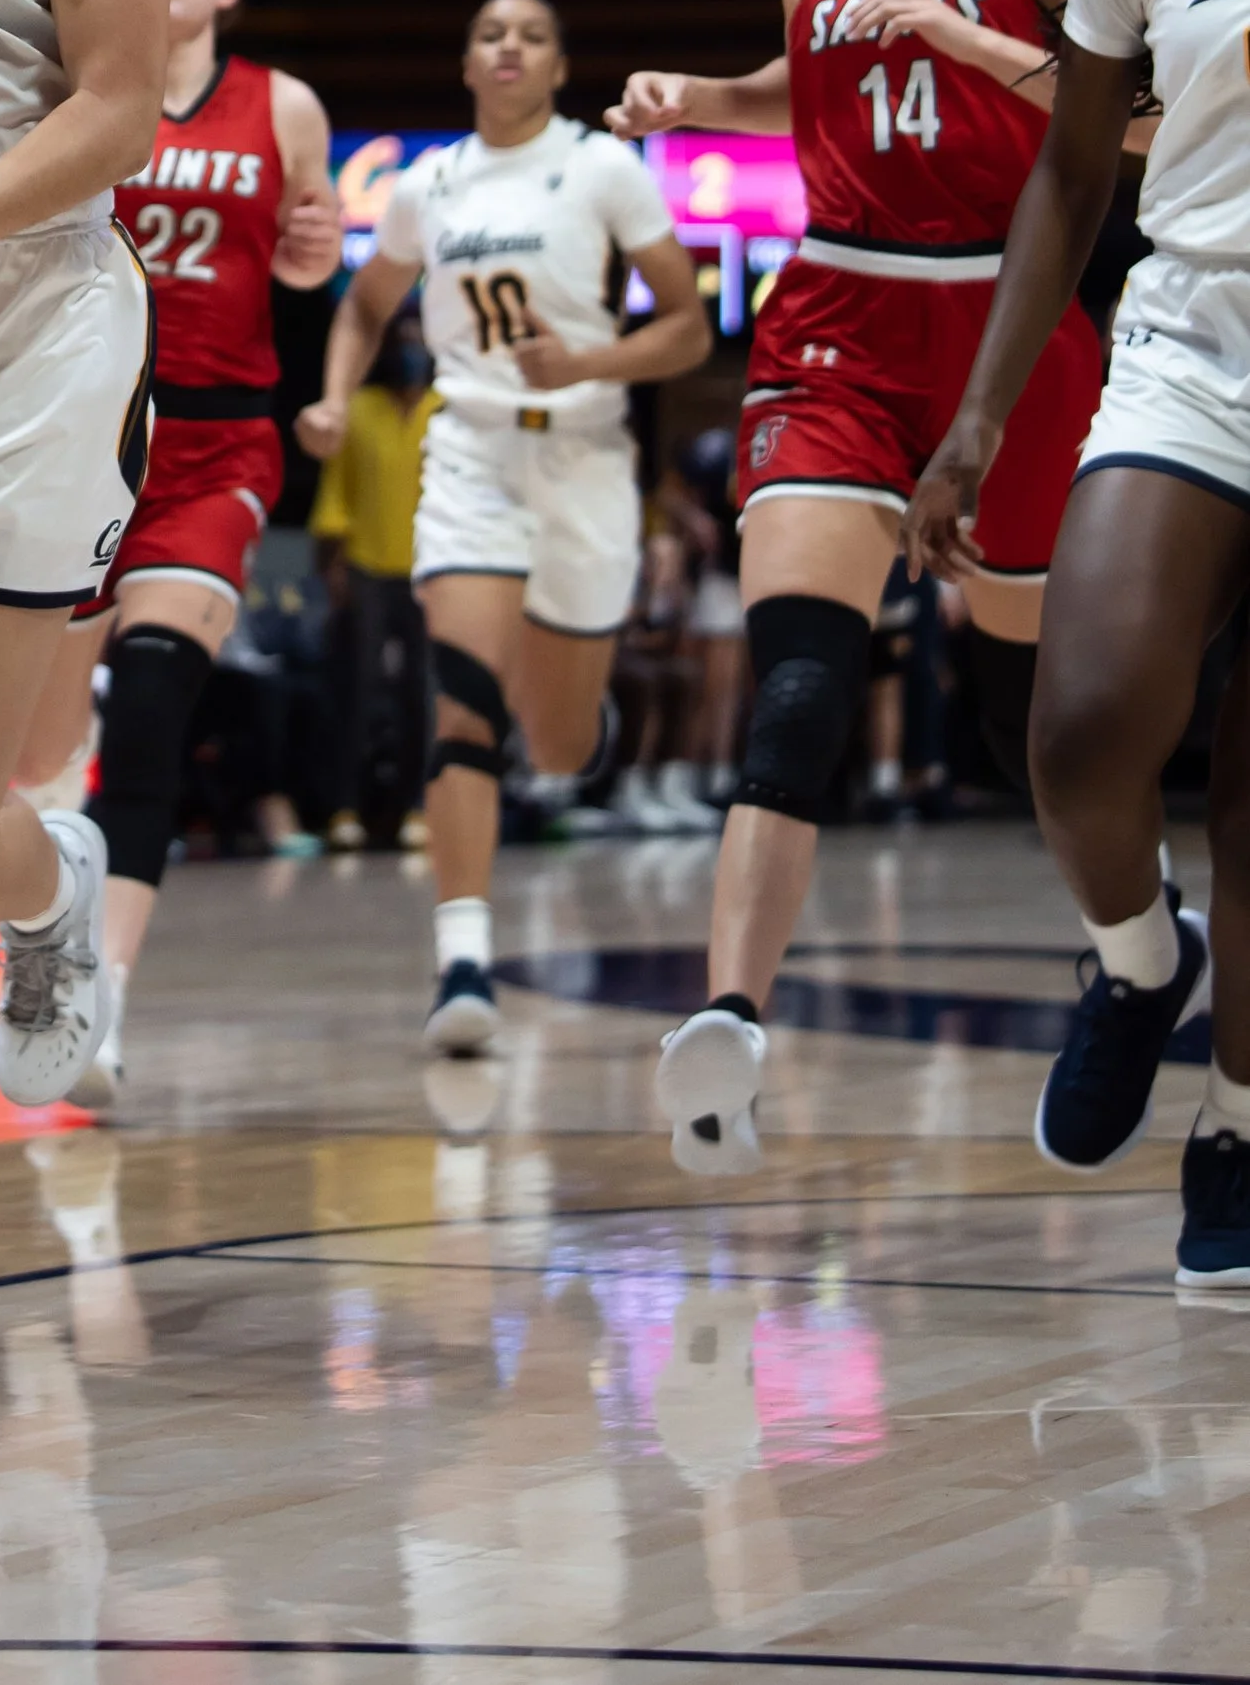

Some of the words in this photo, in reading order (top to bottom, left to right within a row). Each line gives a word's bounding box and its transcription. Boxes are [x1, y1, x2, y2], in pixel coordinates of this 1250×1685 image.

[858, 58, 942, 154] 14
[123, 146, 263, 197] INTS
[136, 203, 222, 282] 22
